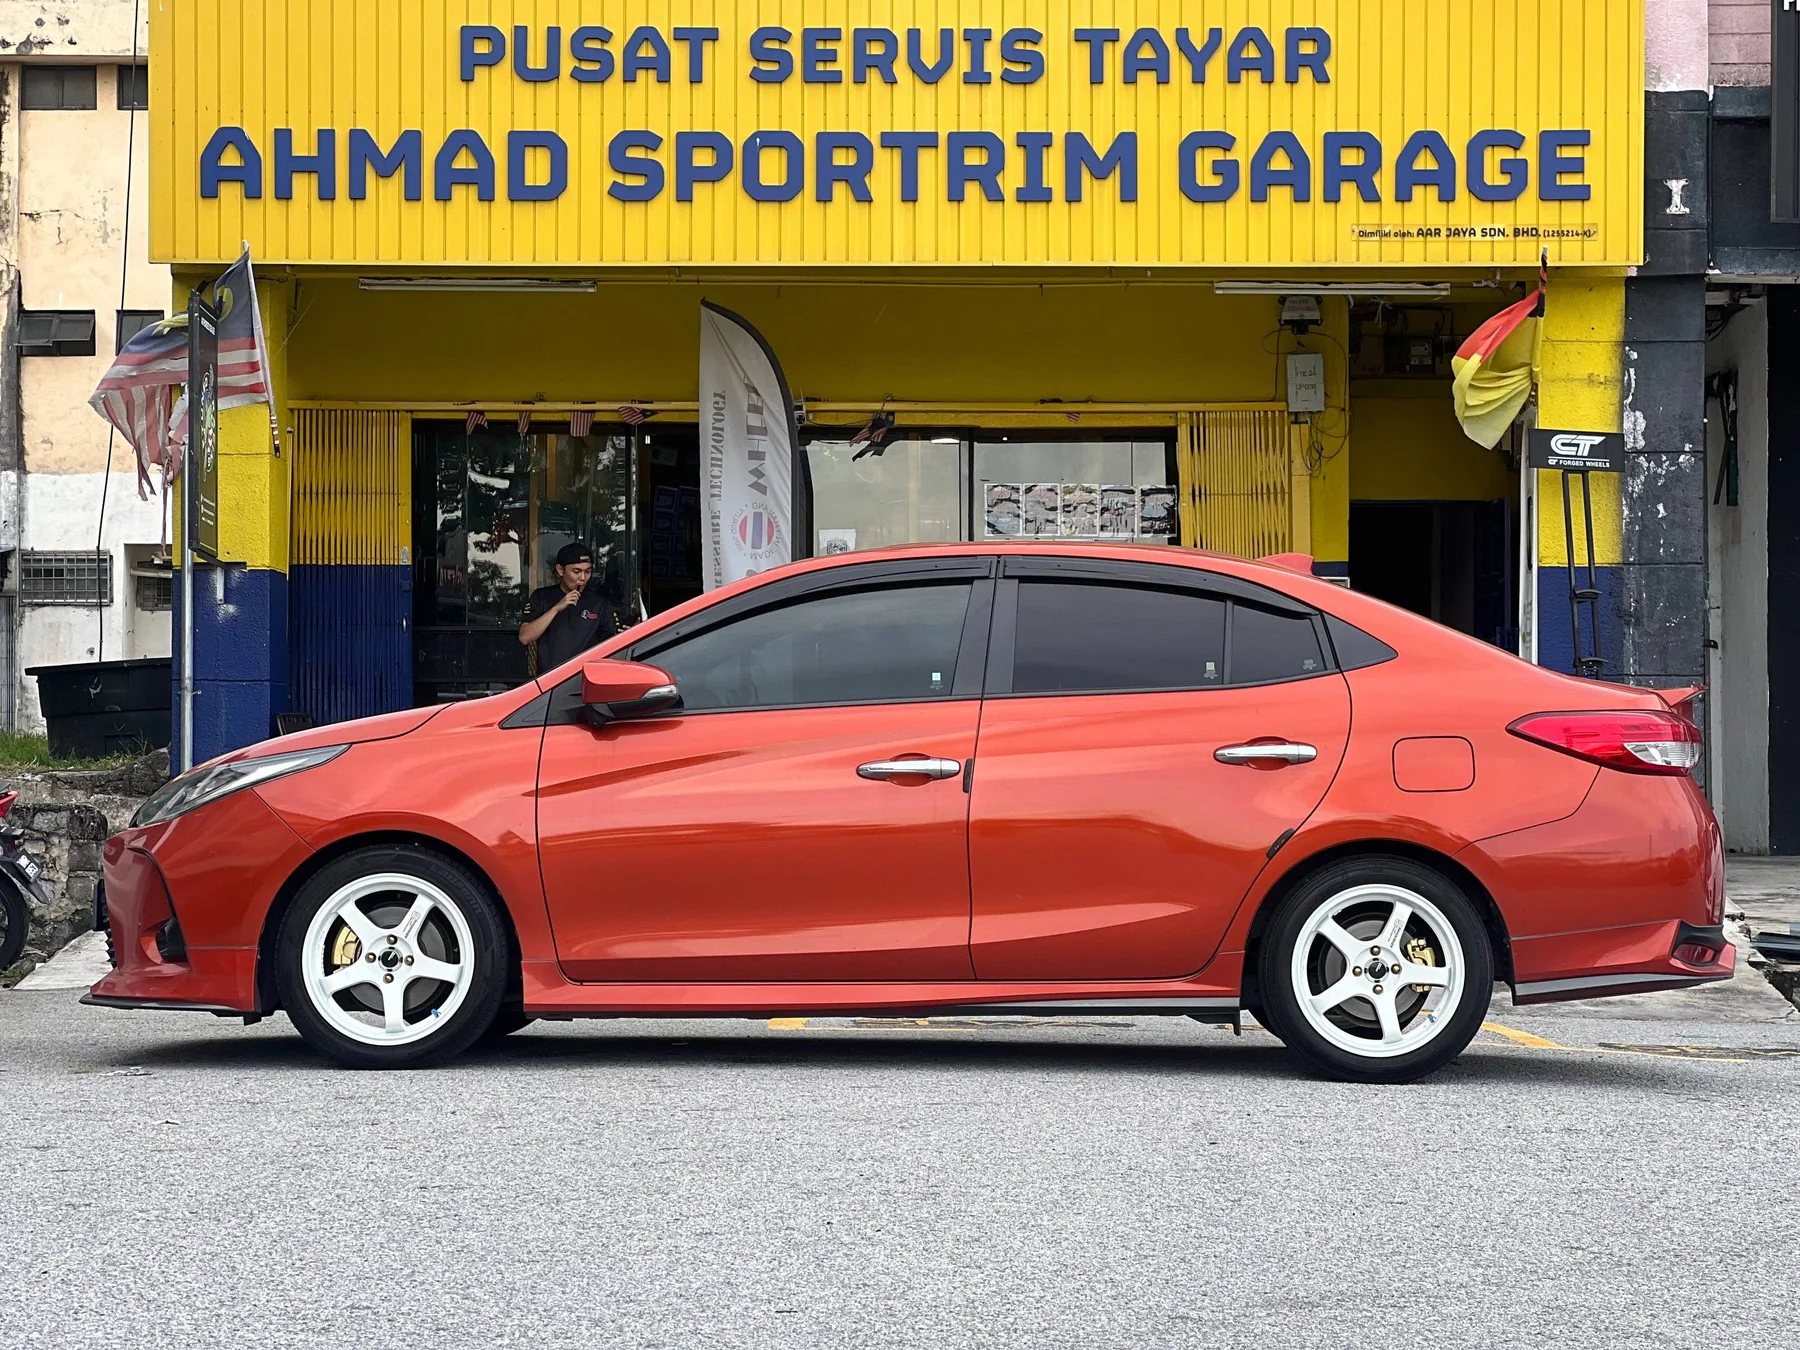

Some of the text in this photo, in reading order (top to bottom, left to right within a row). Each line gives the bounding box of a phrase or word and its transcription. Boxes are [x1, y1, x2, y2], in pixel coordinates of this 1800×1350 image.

[462, 27, 1330, 82] PUSAT SERVIS TAYAR
[202, 128, 1590, 200] AHMAD SPORTRIM GARAGE
[1416, 227, 1441, 238] AAR
[1446, 227, 1476, 238] JAYA
[1480, 227, 1509, 238] SDN.
[1513, 227, 1541, 238] BHD.
